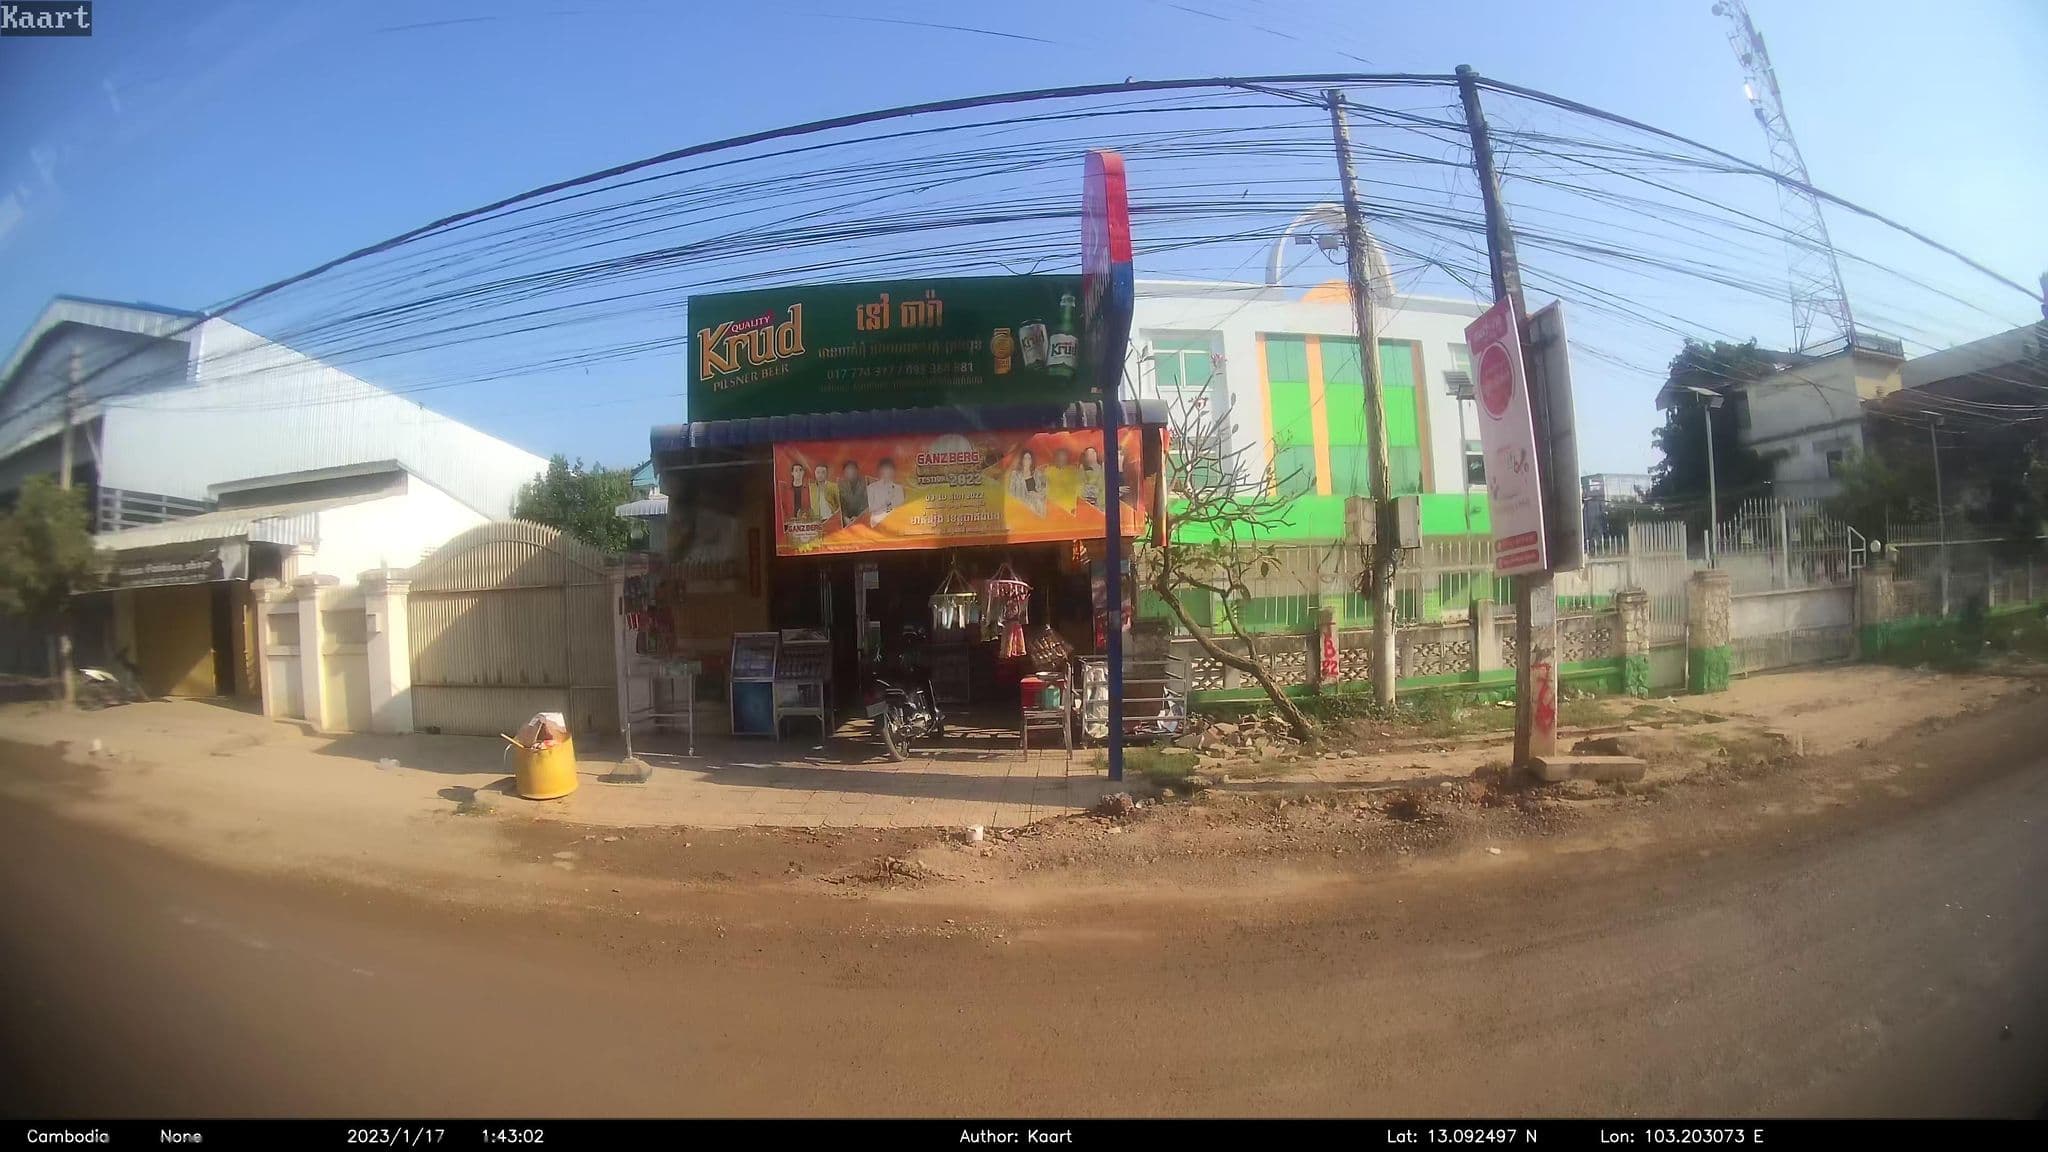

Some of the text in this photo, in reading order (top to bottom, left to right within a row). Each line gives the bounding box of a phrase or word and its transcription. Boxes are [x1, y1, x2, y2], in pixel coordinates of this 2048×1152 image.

[731, 315, 770, 333] QUALITY
[697, 303, 806, 381] Krud
[713, 362, 789, 392] PILSNER BEER
[916, 451, 981, 465] GANZBERG
